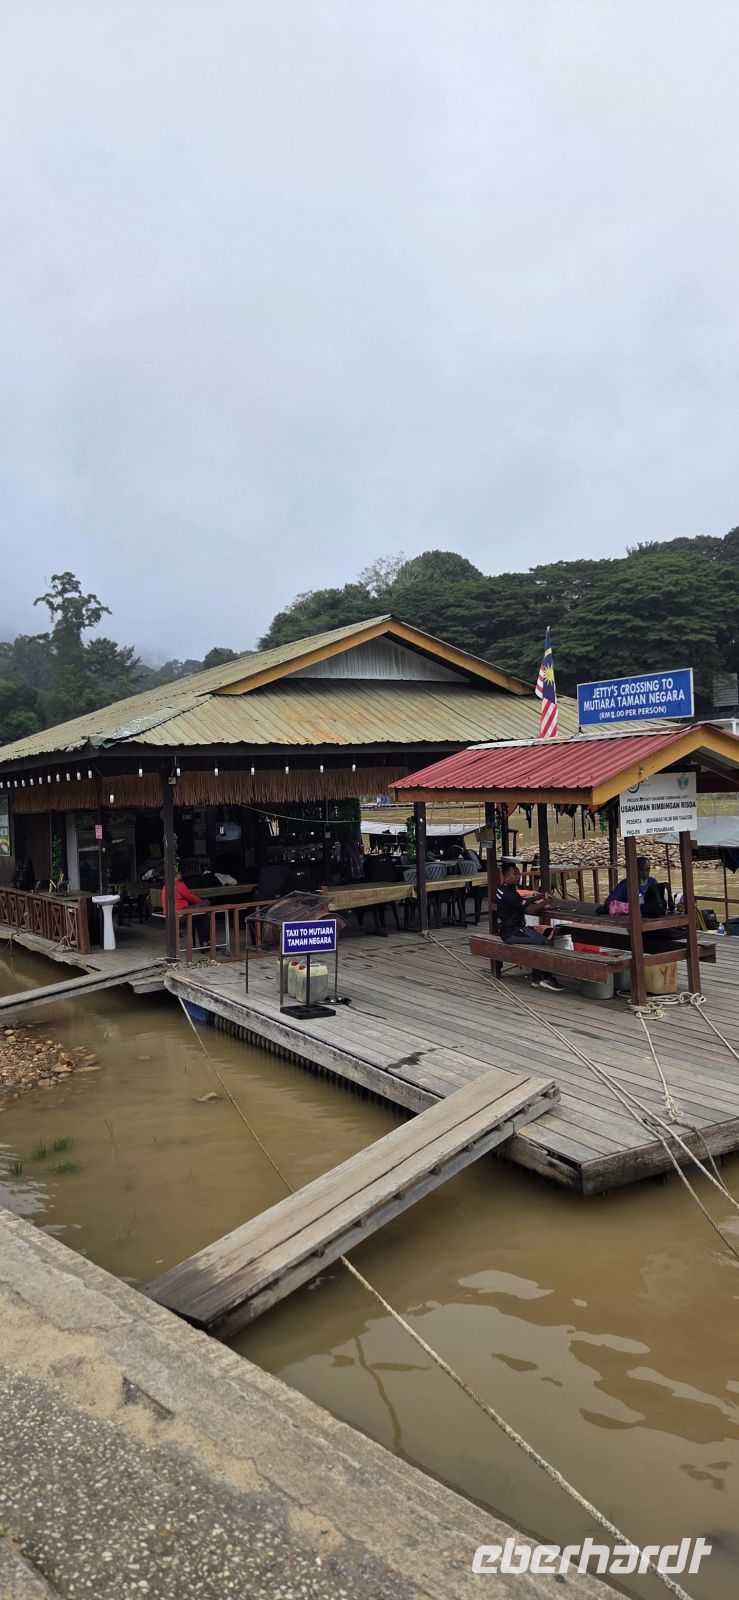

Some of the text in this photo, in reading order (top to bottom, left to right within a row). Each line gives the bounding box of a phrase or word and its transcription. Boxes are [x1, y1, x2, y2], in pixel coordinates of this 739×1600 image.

[593, 678, 673, 698] JETTY'S CROSSING TO
[584, 689, 685, 711] MUTIARA TAMAN NEGARA
[638, 706, 666, 715] PERSON)
[621, 804, 650, 813] USAHAWAN
[652, 802, 680, 810] BIMBINGAN
[309, 927, 333, 935] MUTIARA
[288, 938, 308, 946] TAMAN
